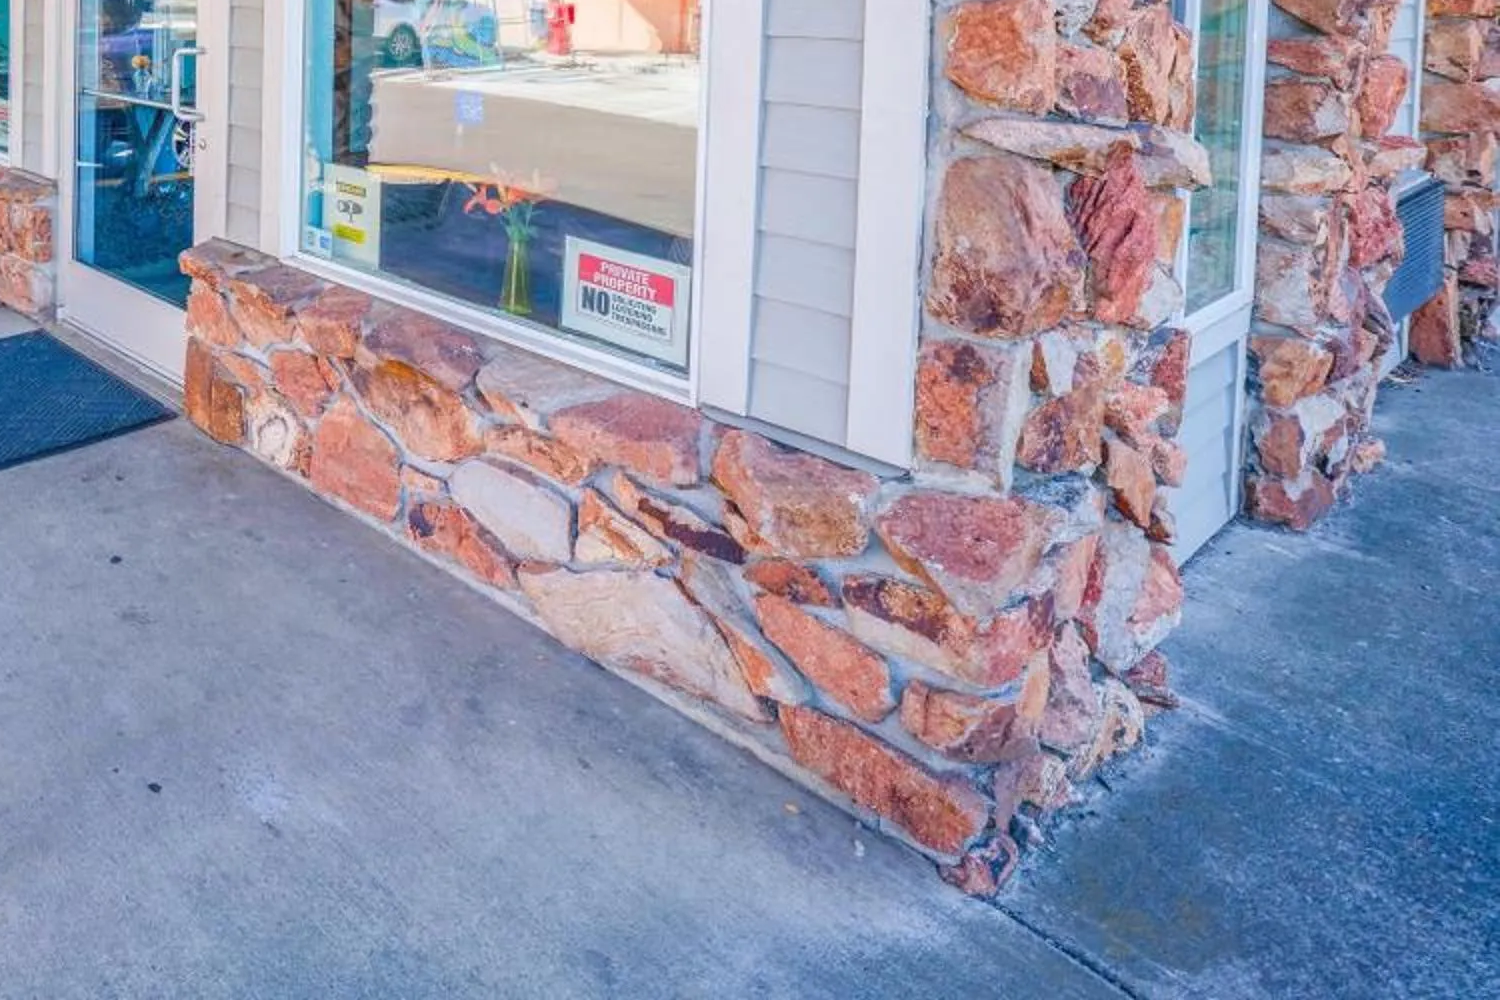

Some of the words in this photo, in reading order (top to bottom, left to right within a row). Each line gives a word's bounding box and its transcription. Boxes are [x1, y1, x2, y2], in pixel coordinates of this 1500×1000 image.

[593, 271, 657, 300] PROPERTY
[601, 261, 649, 285] PRIVATE
[581, 286, 610, 317] NO
